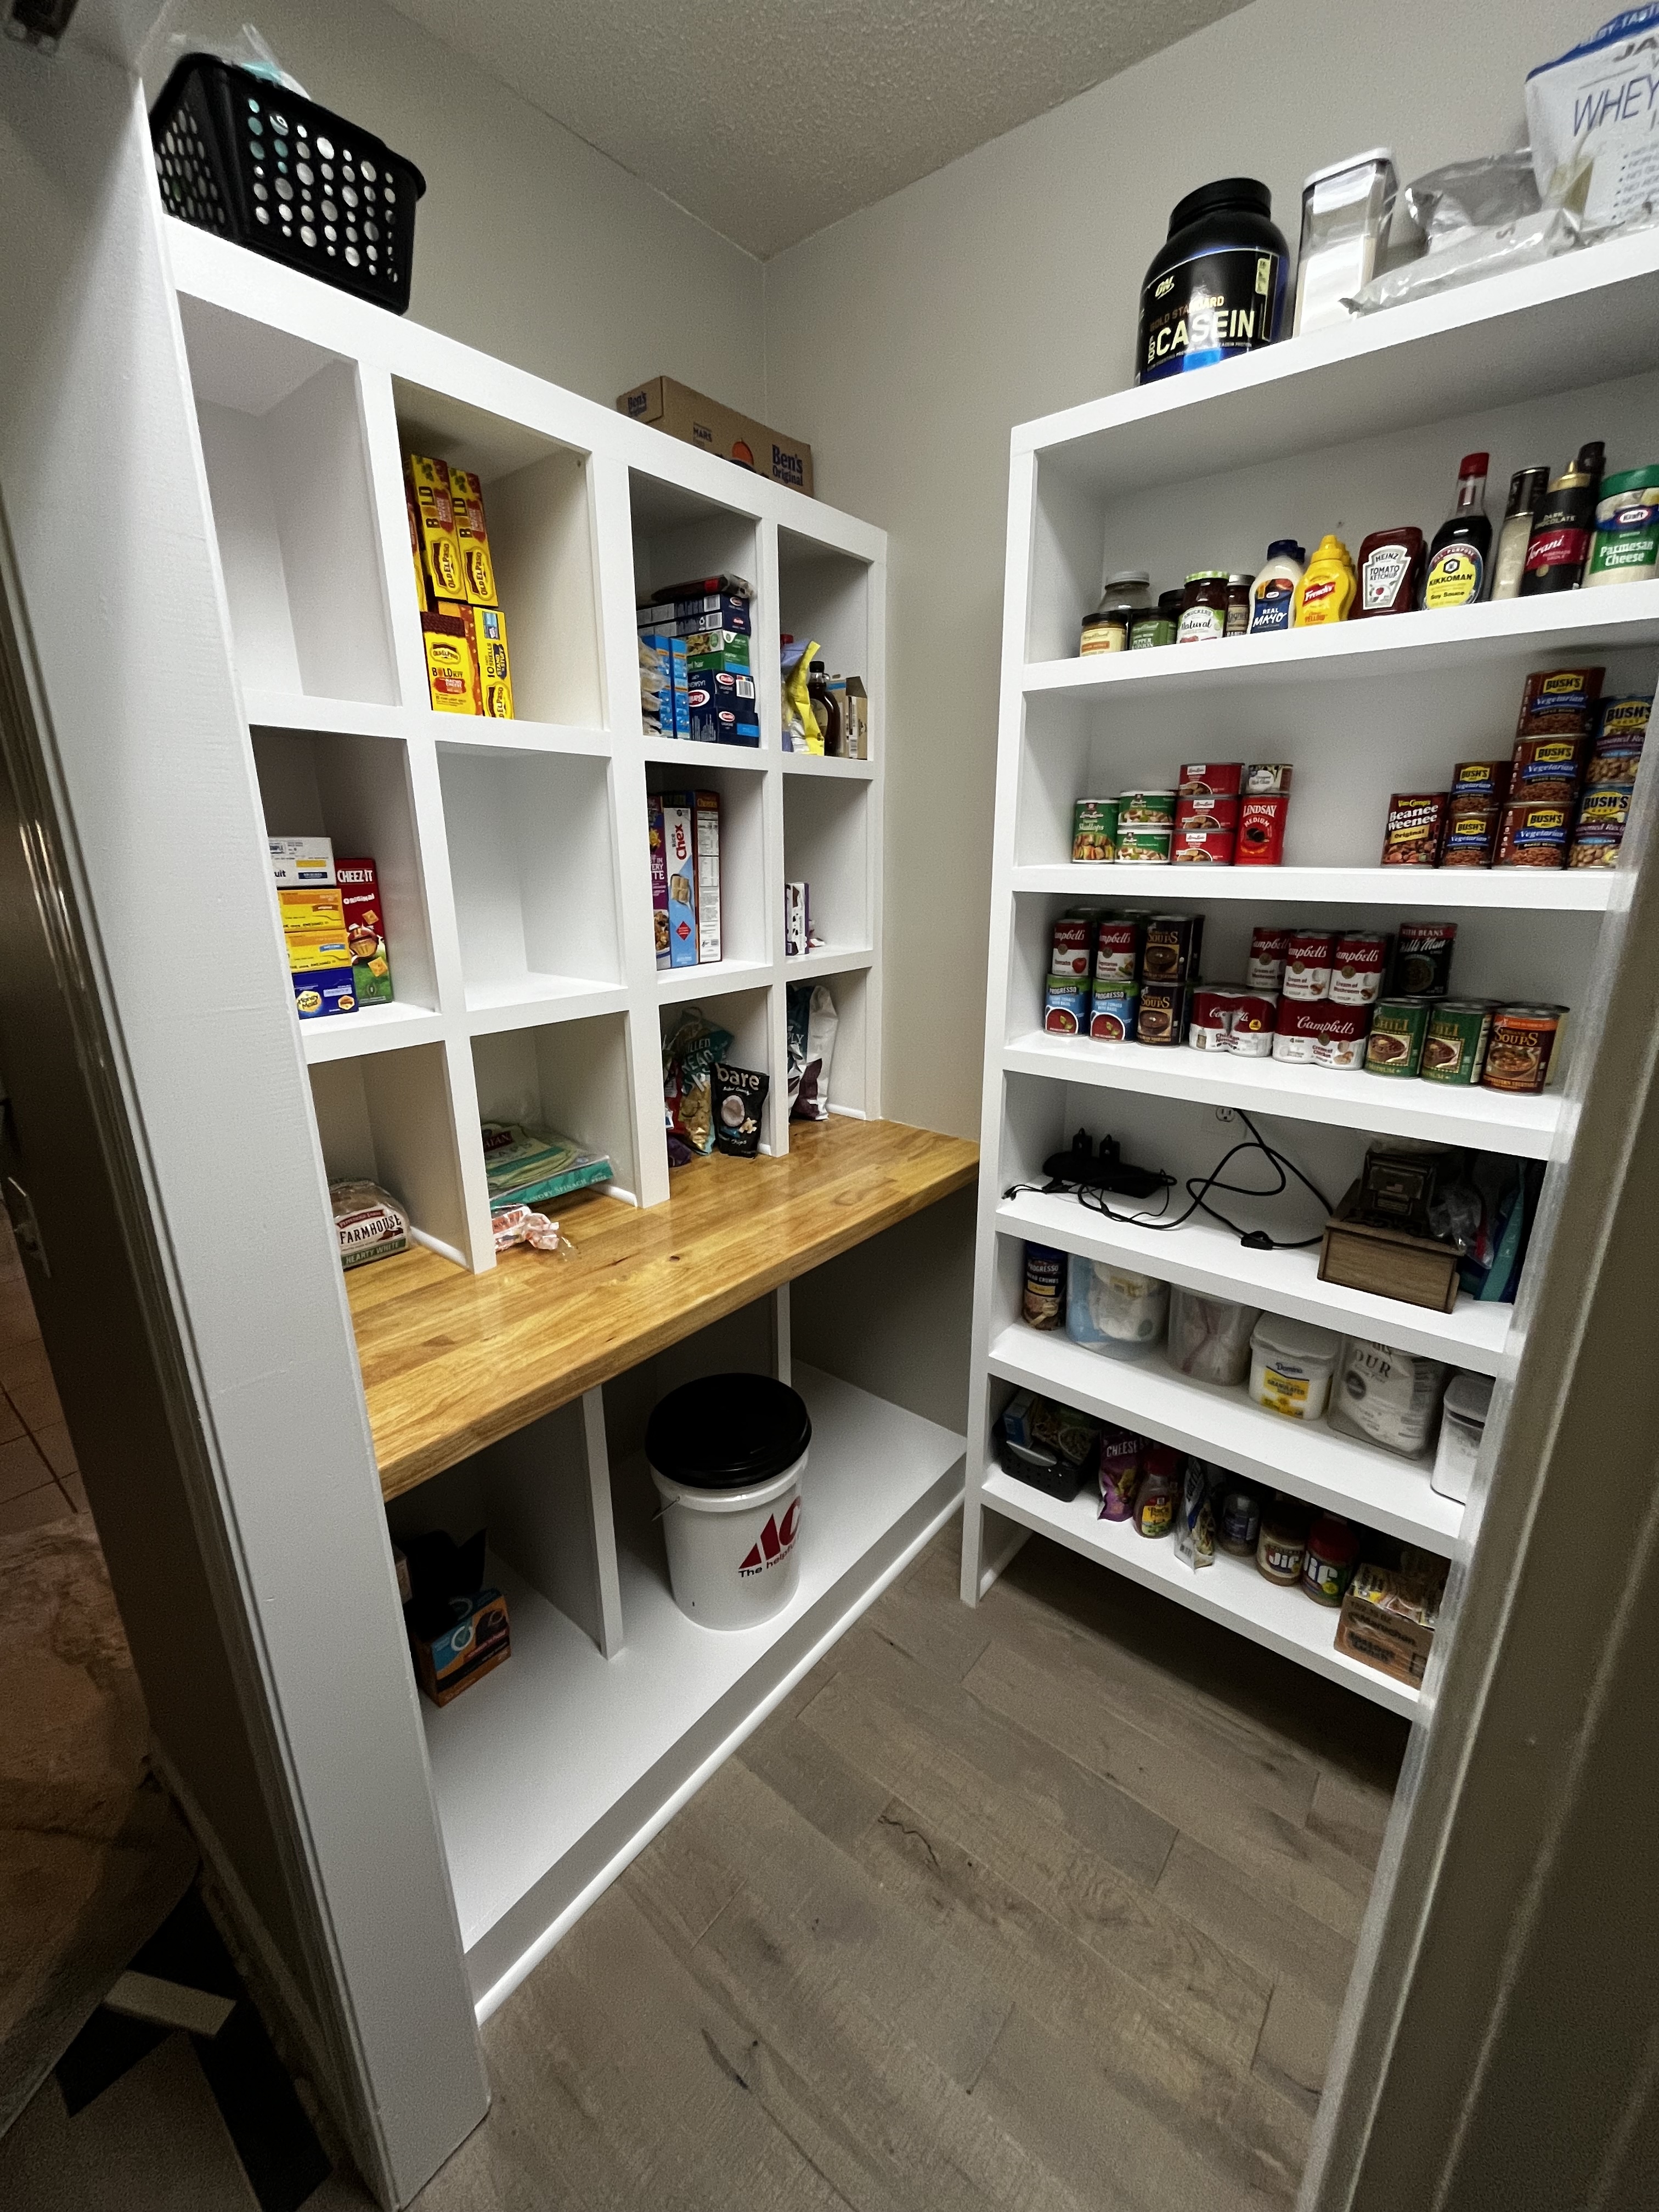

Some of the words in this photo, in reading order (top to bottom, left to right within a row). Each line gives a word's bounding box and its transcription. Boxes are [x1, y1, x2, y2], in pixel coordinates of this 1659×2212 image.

[1172, 296, 1224, 319] STANDARD
[1156, 310, 1255, 356] CASEIN
[693, 427, 713, 442] MARS
[772, 444, 803, 473] Ben's
[772, 466, 803, 486] Original
[1600, 541, 1654, 557] Parmesan
[1375, 553, 1399, 562] HEINZ
[1605, 552, 1645, 567] Cheese
[1370, 565, 1400, 574] TOMATO
[1429, 574, 1473, 586] KIKKOMAN
[1181, 618, 1212, 630] Natural
[1252, 612, 1287, 627] MAYO
[487, 667, 495, 678] 10
[1545, 678, 1582, 690] BUSH'S
[1537, 695, 1584, 706] Vegetarian
[1606, 706, 1652, 723] BUSH'S
[1538, 747, 1572, 758] BUSH'S
[1527, 763, 1575, 772] Vegetarian
[1461, 769, 1489, 779] BUSH'S
[1584, 796, 1629, 810] BUSH'S
[1243, 805, 1277, 817] LINDSAY
[1244, 817, 1270, 827] MEDIUM
[1530, 814, 1562, 824] BUSH'S
[1457, 822, 1486, 832] BUSH'S
[1394, 828, 1425, 839] Original
[1520, 830, 1565, 838] Vegetarian
[675, 823, 687, 860] Chex
[1049, 986, 1076, 995] PROGRESSO
[1095, 991, 1125, 1000] PROGRESSO
[1141, 994, 1170, 1008] SOUPS
[1494, 1026, 1538, 1047] SOUPS
[715, 1062, 760, 1091] bare
[554, 1178, 586, 1195] SPINACH
[340, 1215, 402, 1244] FARMHOUSE
[346, 1250, 374, 1264] HEARTY
[376, 1241, 399, 1254] WHITE
[1276, 1362, 1303, 1373] Domino
[1269, 1553, 1299, 1568] Jif
[738, 1566, 763, 1578] The
